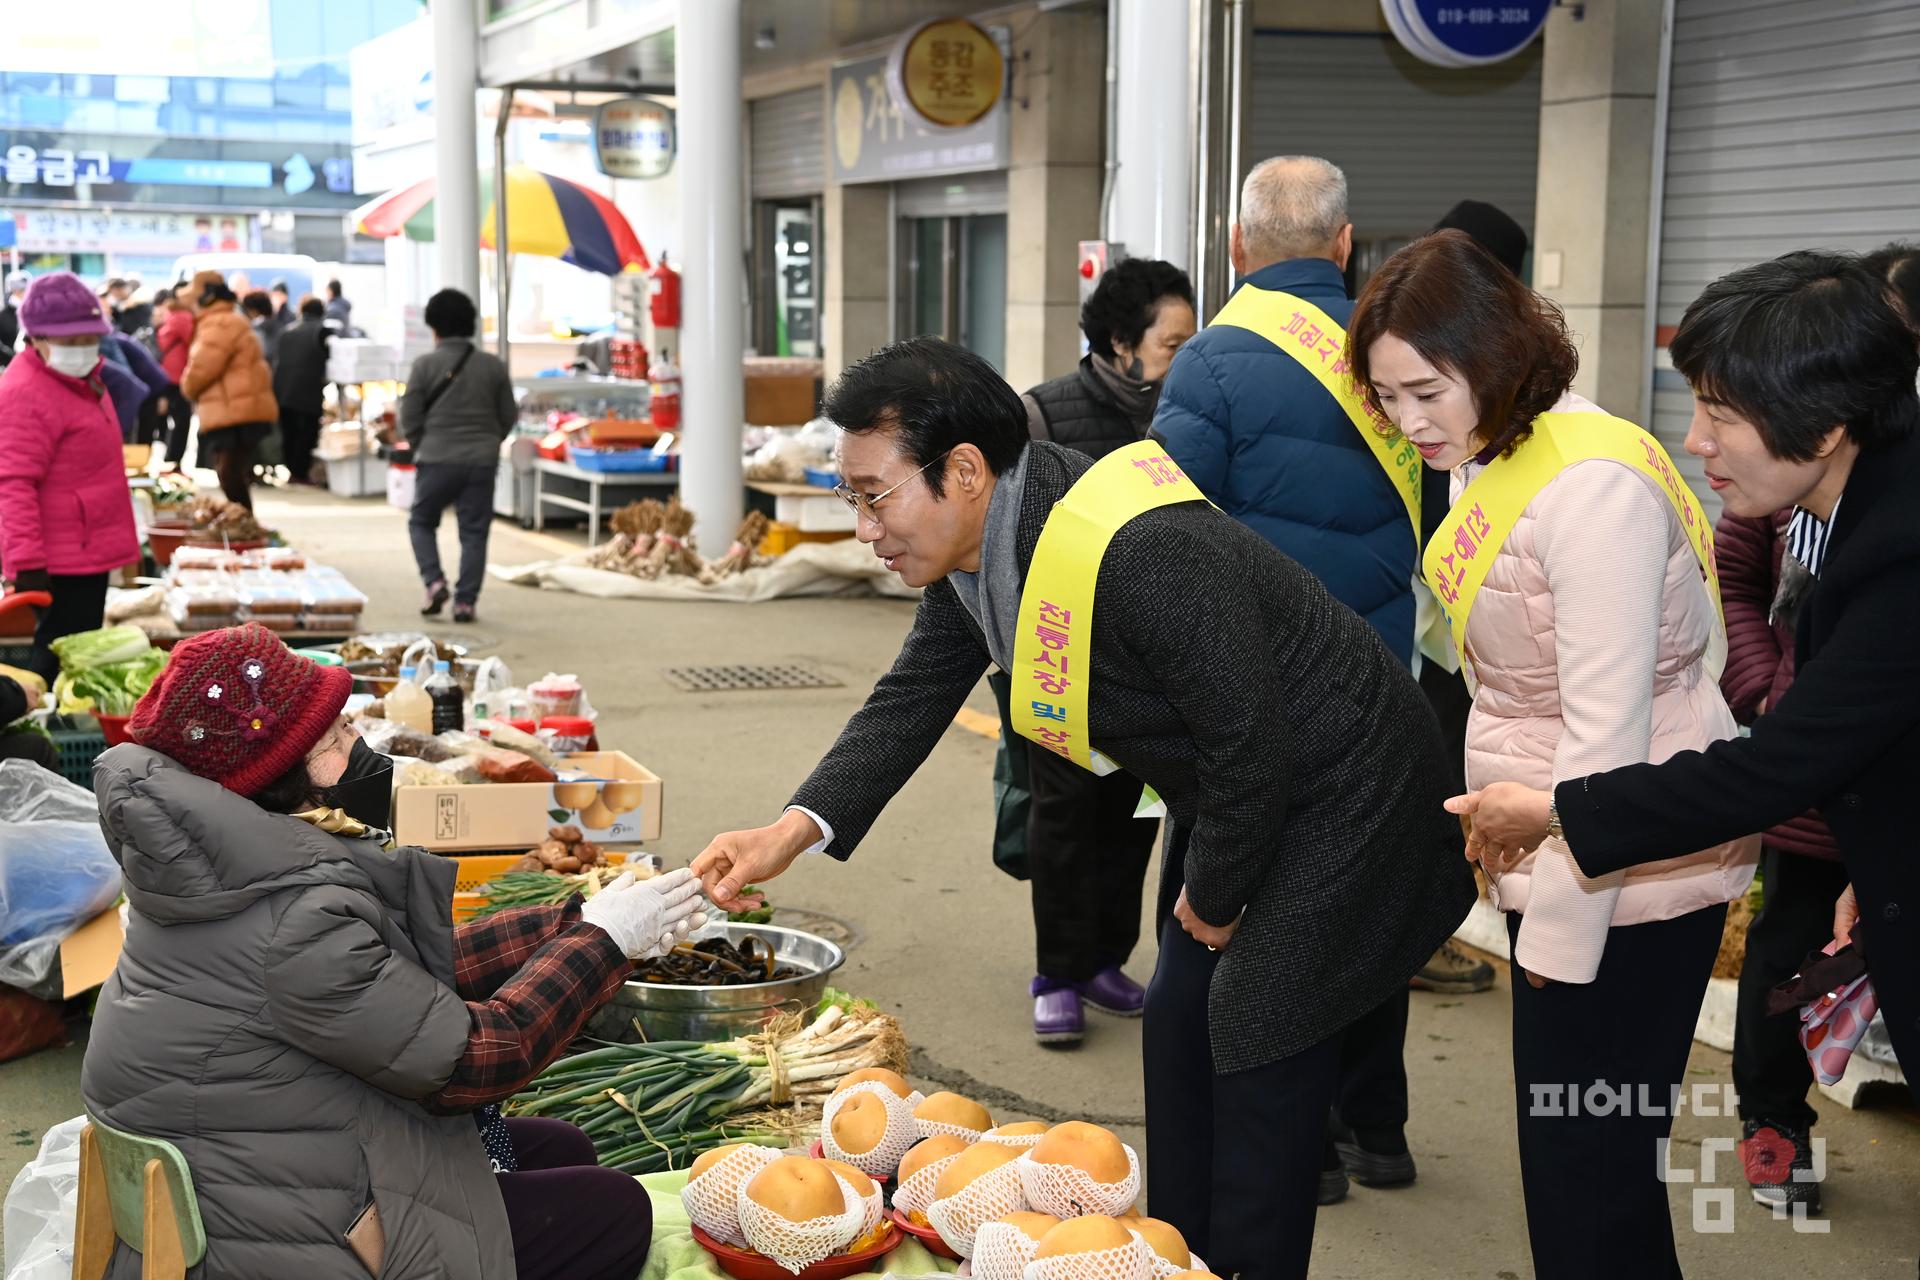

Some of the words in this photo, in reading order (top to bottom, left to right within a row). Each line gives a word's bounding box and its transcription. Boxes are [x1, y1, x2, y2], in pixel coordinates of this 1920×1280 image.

[0, 145, 113, 186] 을금고
[1435, 501, 1492, 605] 전통시장
[1033, 599, 1072, 696] 전통시장
[1031, 700, 1067, 723] 및
